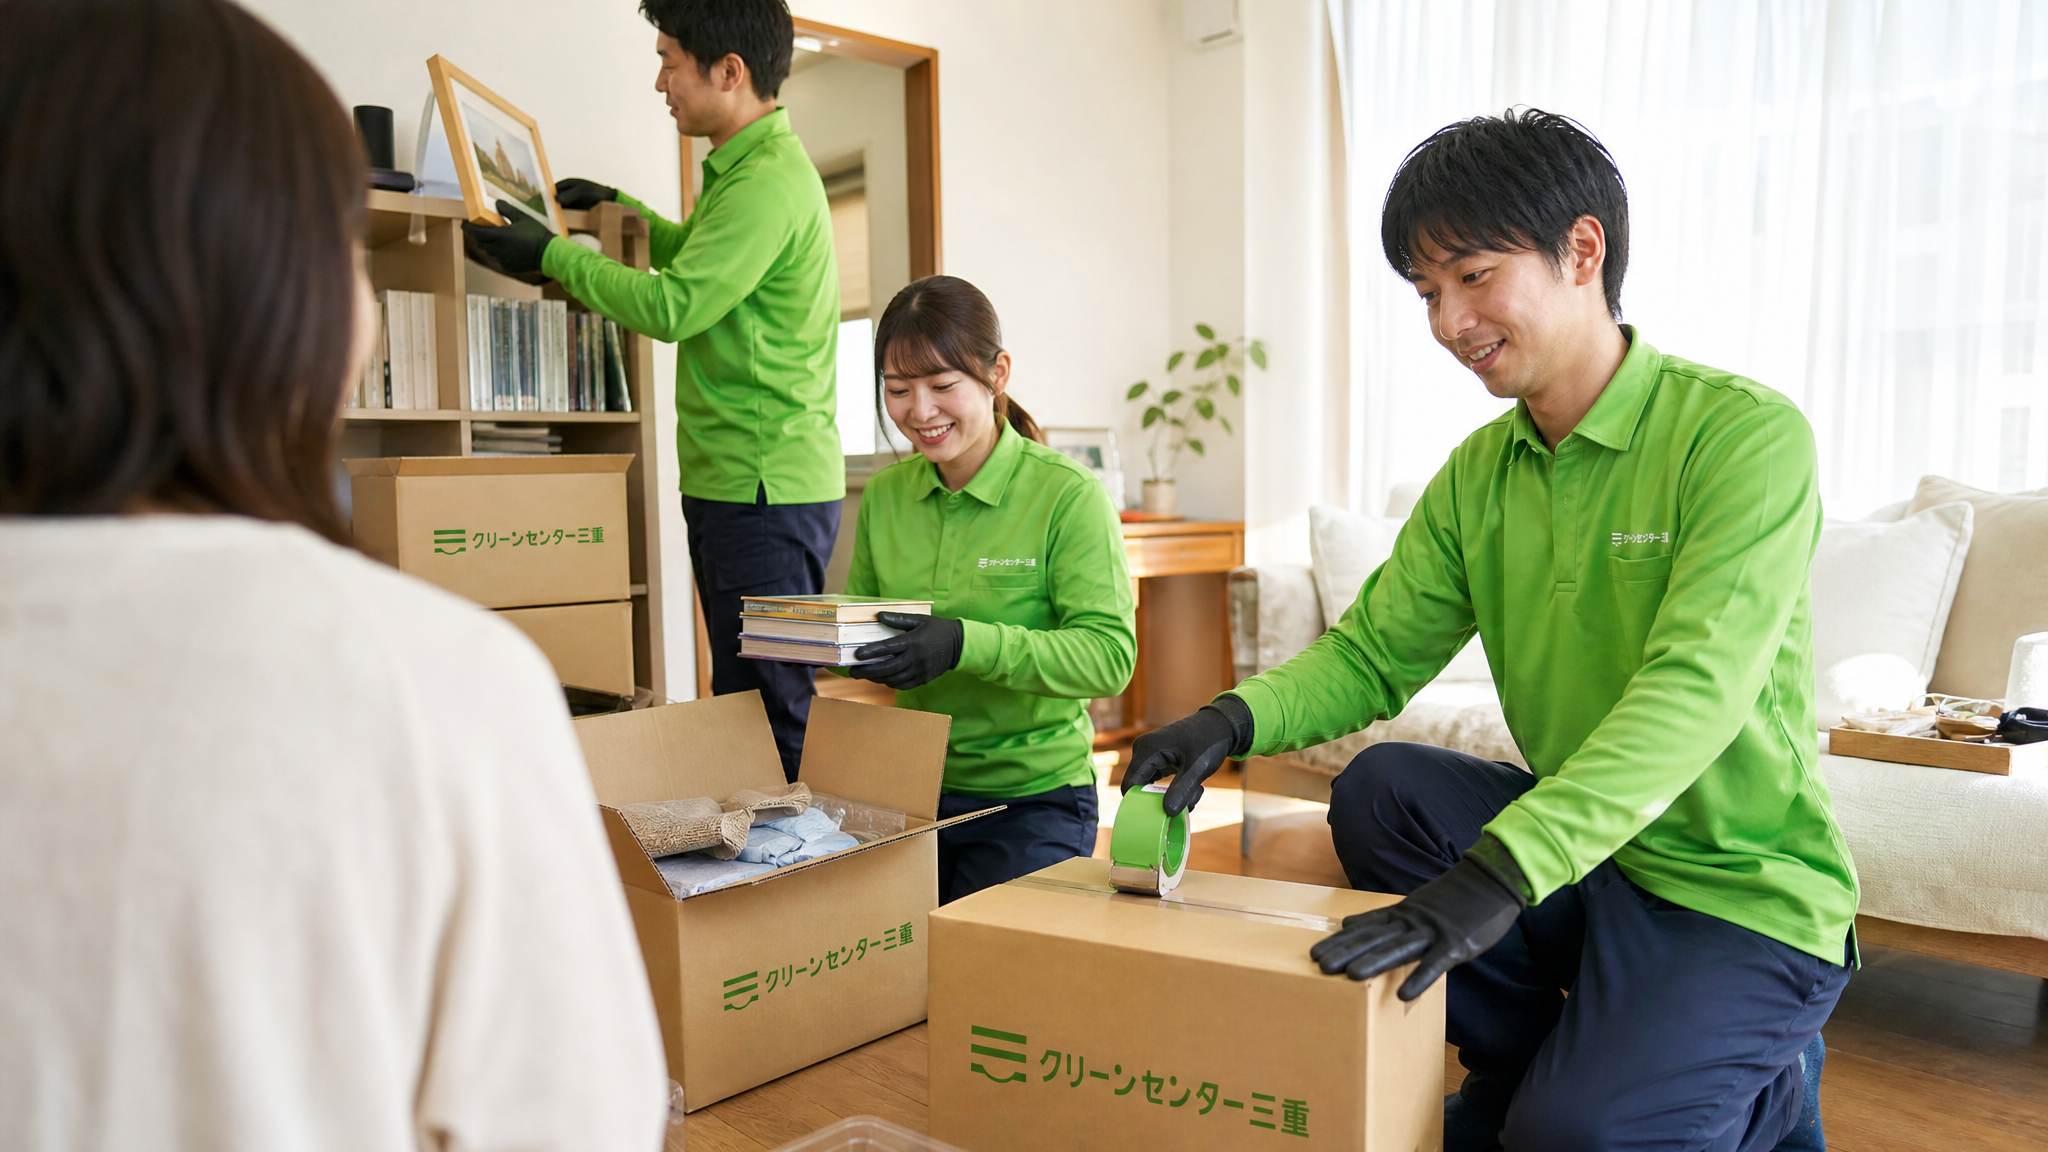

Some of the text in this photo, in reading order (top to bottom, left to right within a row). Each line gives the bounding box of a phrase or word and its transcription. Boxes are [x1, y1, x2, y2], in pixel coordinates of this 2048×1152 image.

[472, 526, 604, 549] クリーンセンター三重
[765, 922, 913, 993] クリーンセンター三重
[1040, 1049, 1310, 1138] クリーンセンター三重
